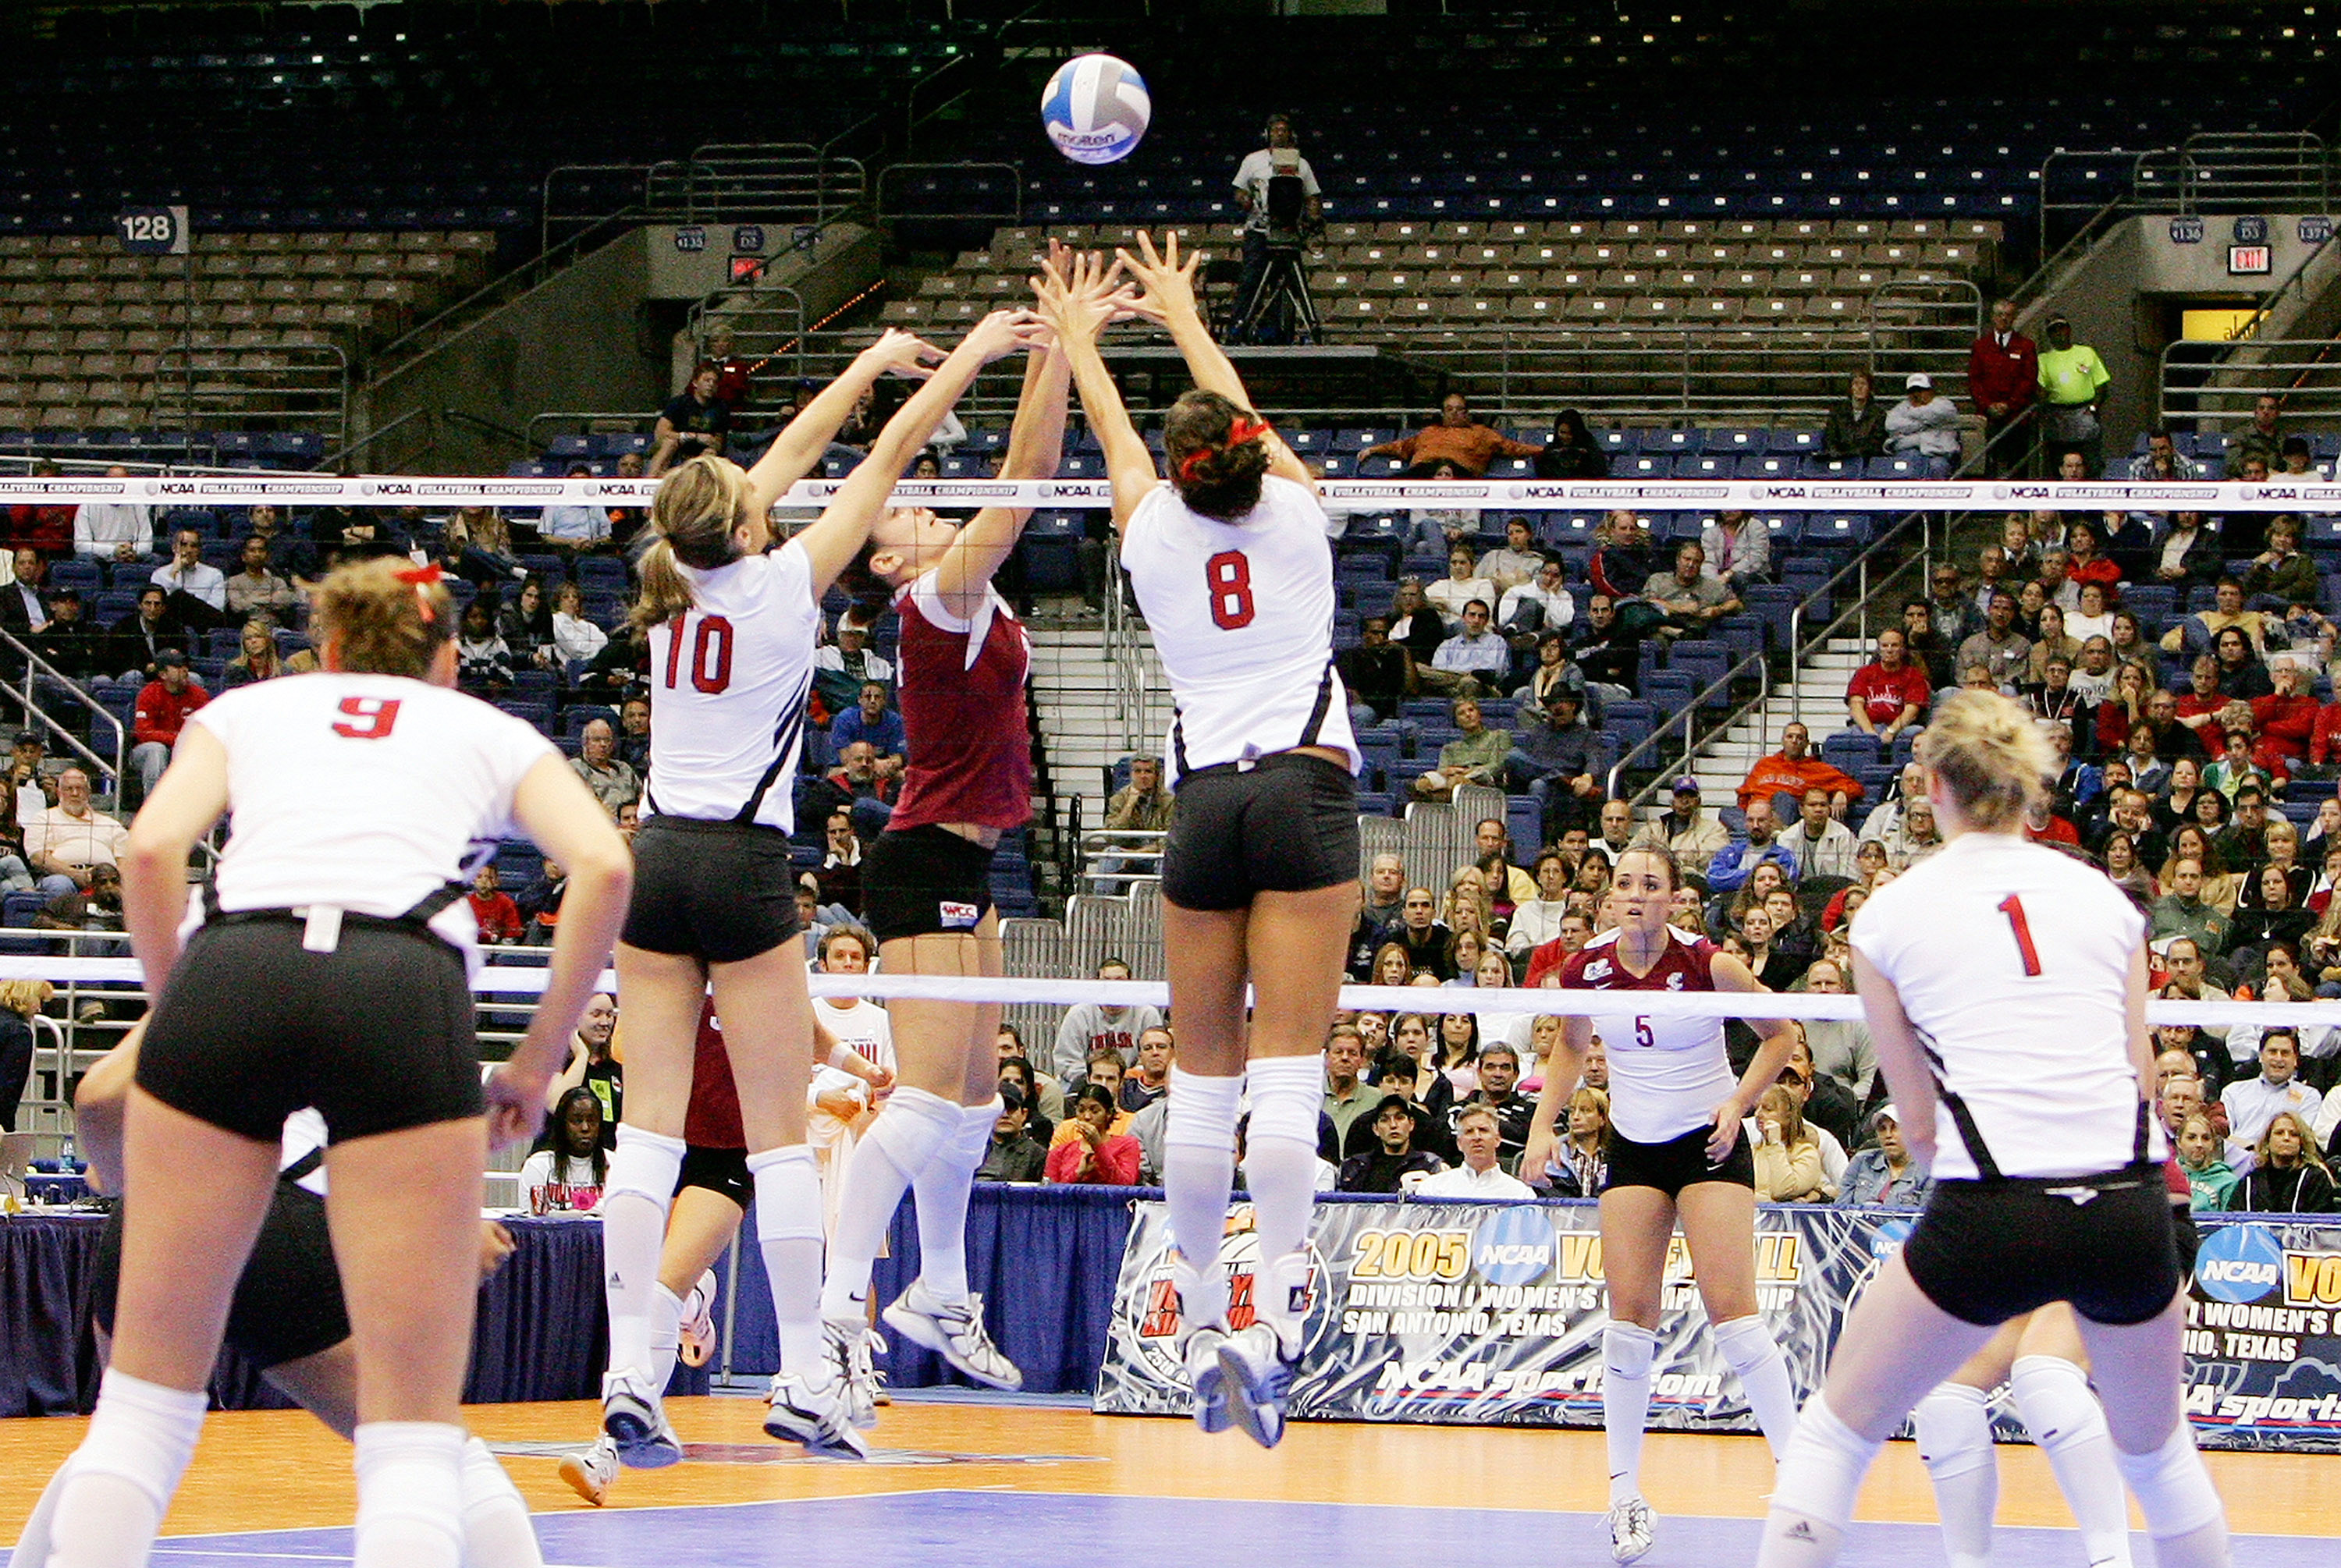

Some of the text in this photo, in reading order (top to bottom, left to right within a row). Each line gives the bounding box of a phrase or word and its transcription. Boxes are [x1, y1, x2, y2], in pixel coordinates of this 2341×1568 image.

[122, 215, 170, 241] 128
[2236, 249, 2263, 269] EXIT
[160, 483, 195, 494] NCAA
[376, 484, 412, 495] NCAA
[599, 484, 634, 495] NCAA
[1055, 485, 1091, 496] NCAA
[1526, 487, 1564, 498] NCAA
[1766, 488, 1806, 498] NCAA
[2009, 488, 2049, 498] NCAA
[2257, 488, 2297, 498] NCAA
[1206, 548, 1255, 630] 8
[666, 613, 733, 694] 10
[332, 697, 401, 740] 9
[942, 905, 975, 918] WCC
[1998, 893, 2042, 977] 1
[1635, 1014, 1654, 1048] 5
[1350, 1230, 1471, 1281] 2005
[1478, 1244, 1551, 1265] NCAA
[1874, 1241, 1899, 1254] NC
[2202, 1260, 2278, 1286] NCAA
[1349, 1284, 1461, 1307] DIVISION
[1465, 1286, 1476, 1307] I
[1480, 1286, 1597, 1310] WOMEN'S
[1343, 1311, 1567, 1336] SAN ANTONIO, TEXAS
[2188, 1301, 2200, 1325] I
[2204, 1302, 2329, 1335] WOMEN'S
[2225, 1332, 2297, 1362] TEXAS
[1377, 1360, 1487, 1391] NCAA
